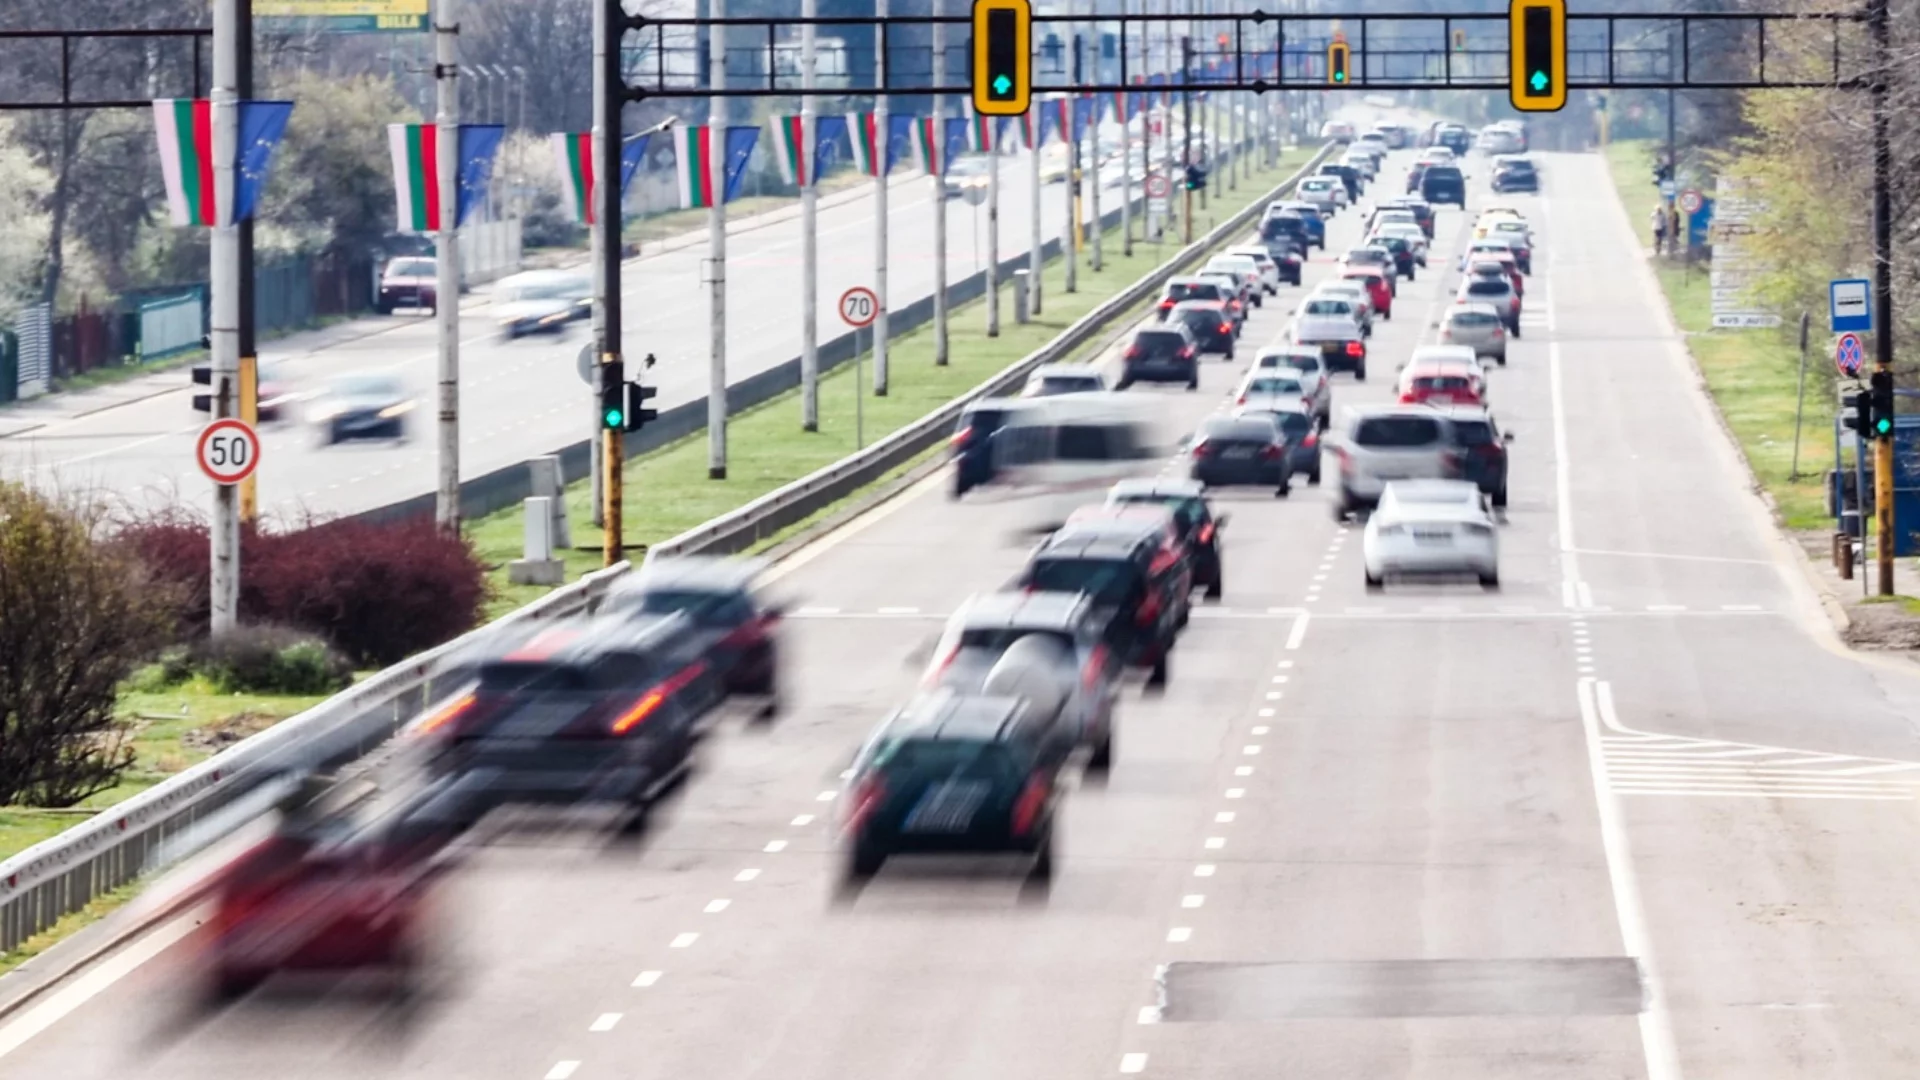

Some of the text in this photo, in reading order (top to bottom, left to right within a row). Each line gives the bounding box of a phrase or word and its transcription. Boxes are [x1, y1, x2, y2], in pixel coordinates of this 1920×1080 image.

[377, 15, 419, 28] BILLA
[847, 297, 869, 316] 70
[211, 436, 246, 466] 50
